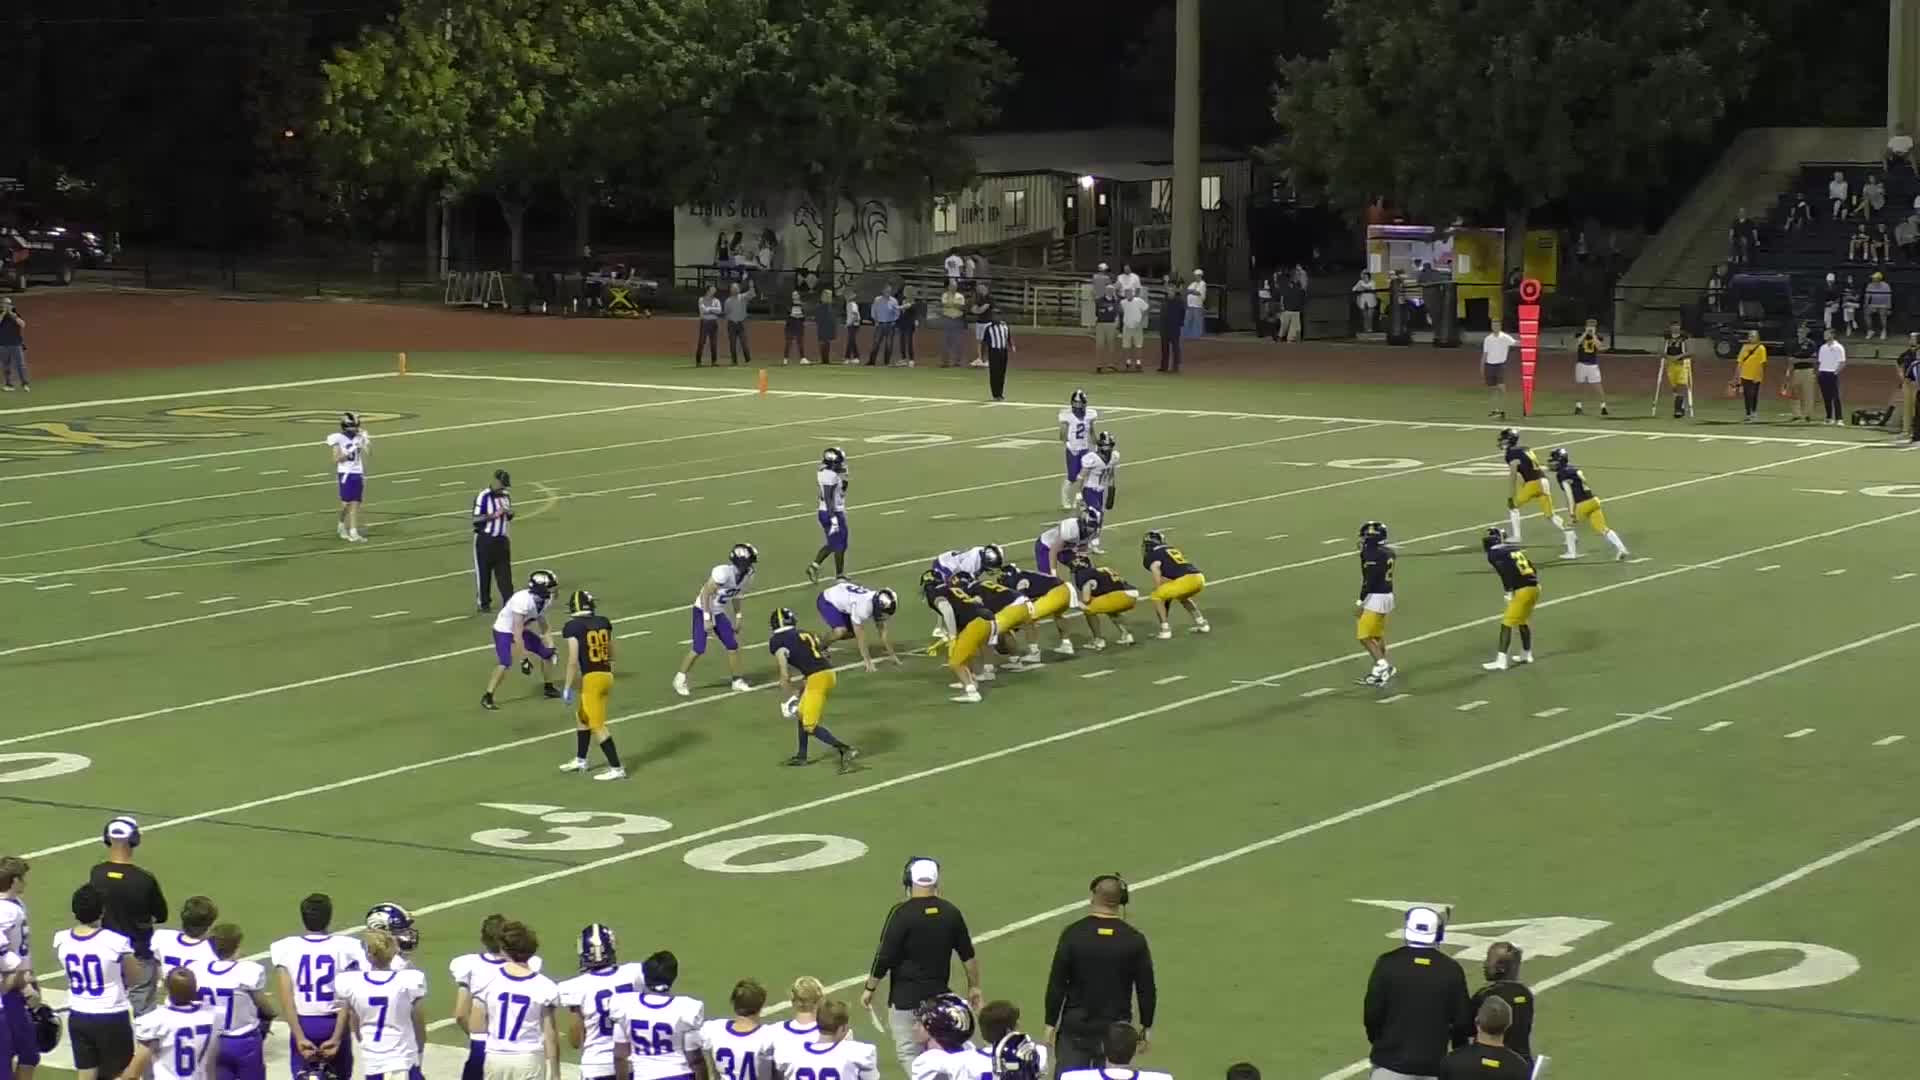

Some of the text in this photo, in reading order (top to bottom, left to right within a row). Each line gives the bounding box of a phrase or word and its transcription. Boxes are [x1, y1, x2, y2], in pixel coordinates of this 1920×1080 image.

[1075, 422, 1086, 440] 2
[65, 953, 104, 997] 60
[297, 954, 335, 1003] 42
[368, 996, 389, 1042] 7
[498, 991, 531, 1042] 17
[630, 1018, 674, 1056] 56
[175, 1024, 213, 1077] 67
[715, 1047, 756, 1080] 34
